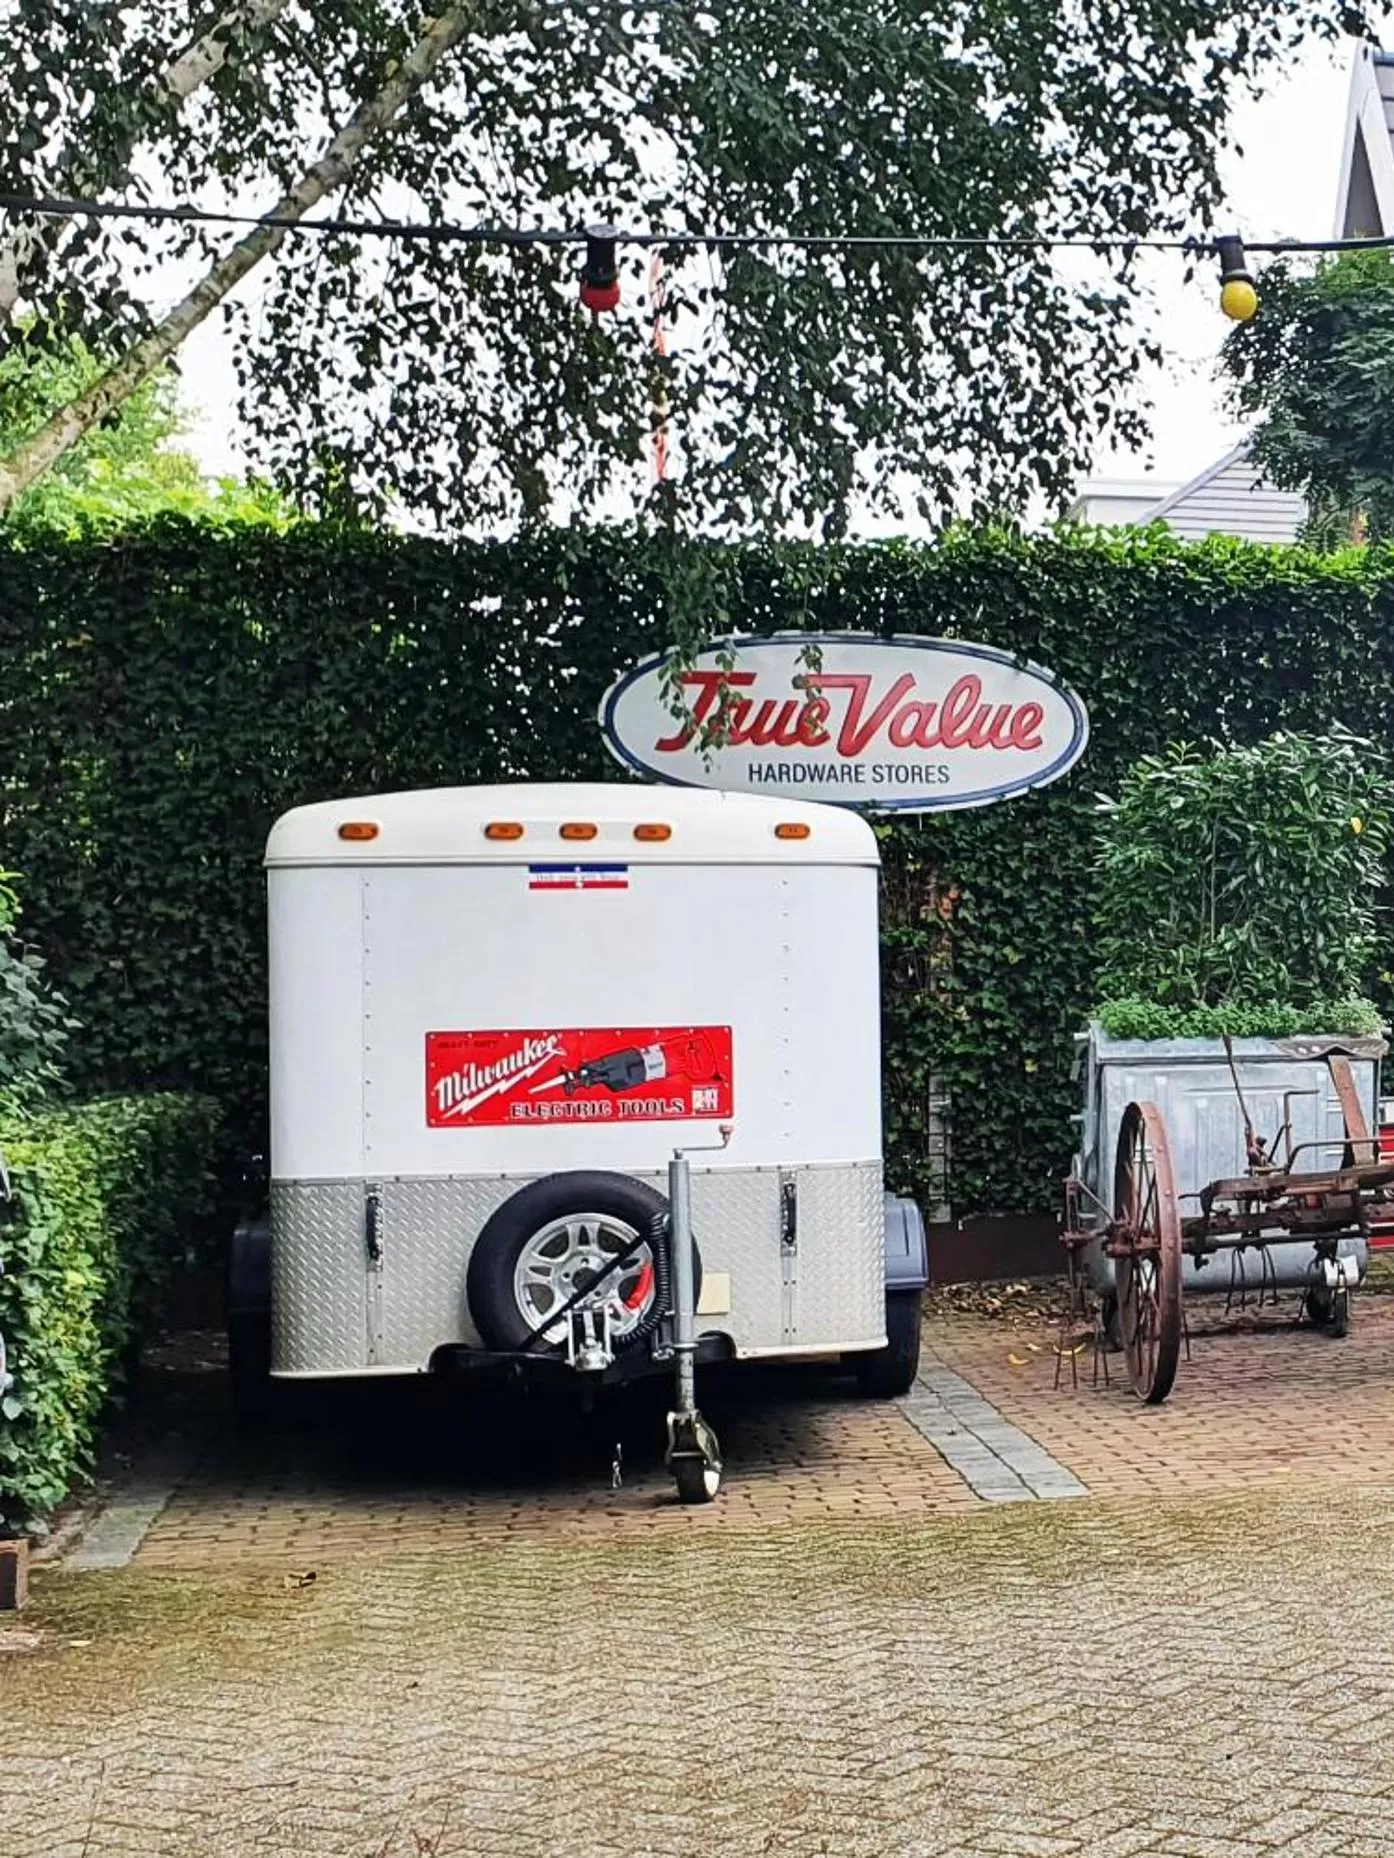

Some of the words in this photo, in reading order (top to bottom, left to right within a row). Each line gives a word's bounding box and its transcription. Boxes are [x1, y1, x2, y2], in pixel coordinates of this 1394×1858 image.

[655, 671, 831, 752] True
[807, 672, 1044, 757] Value
[748, 763, 866, 784] HARDWARE
[872, 763, 950, 785] STORES
[435, 1034, 558, 1111] Milwaukee
[510, 1100, 612, 1118] ELECTRIC
[619, 1097, 684, 1115] TOOLS
